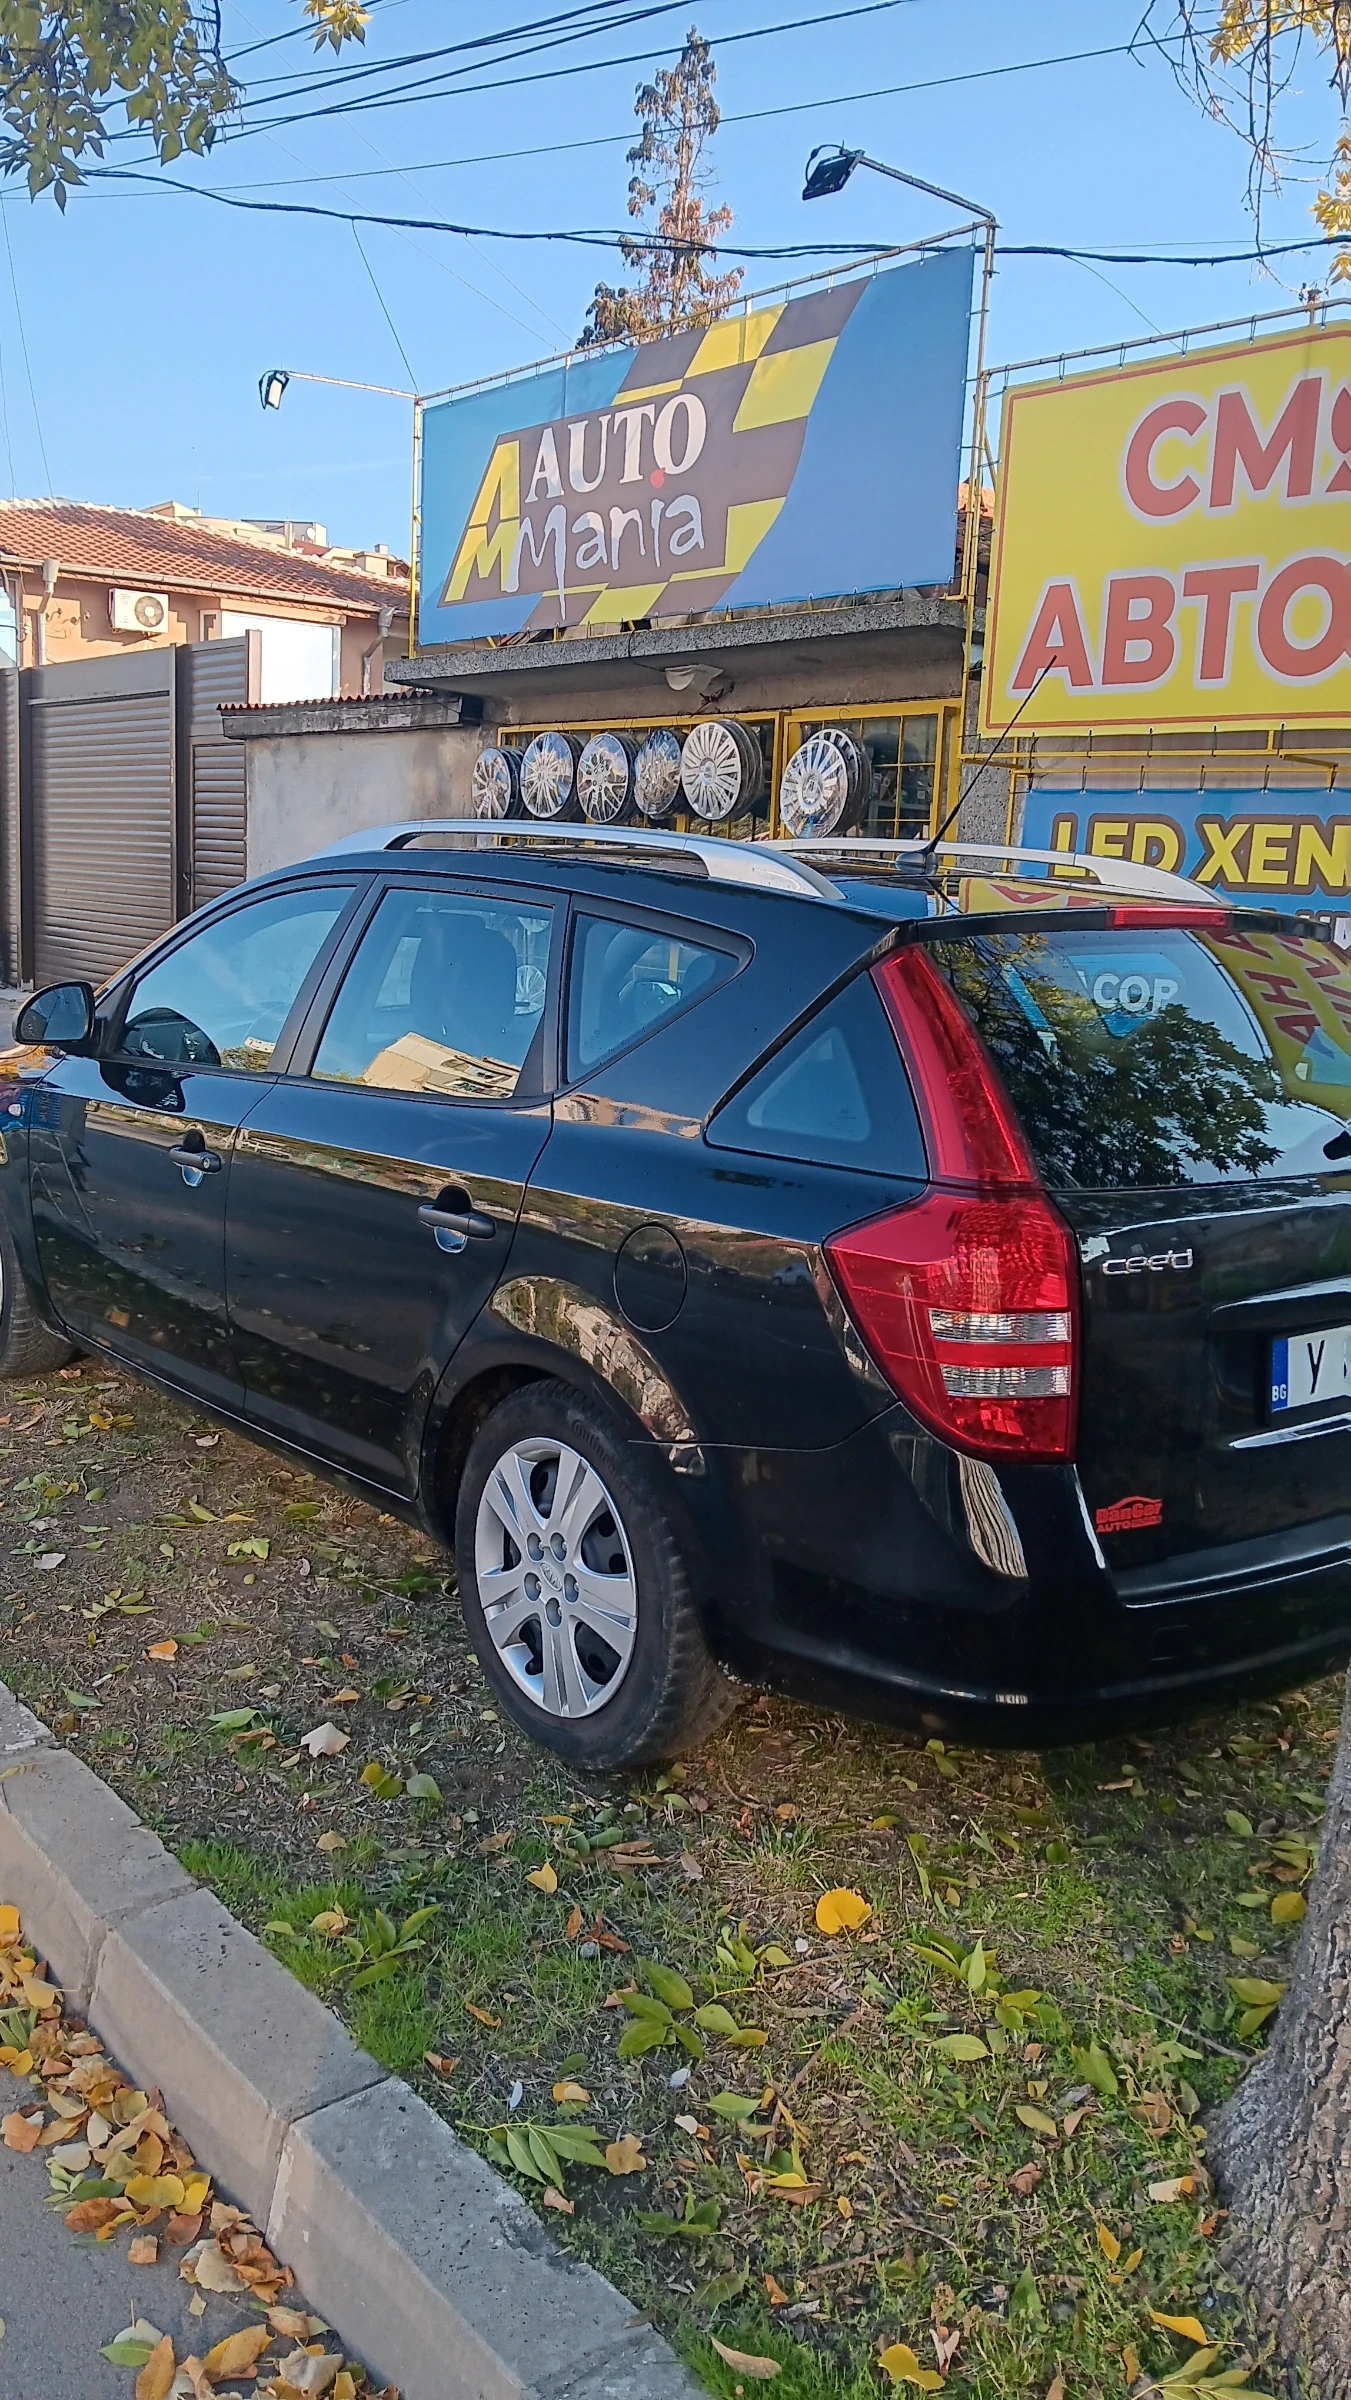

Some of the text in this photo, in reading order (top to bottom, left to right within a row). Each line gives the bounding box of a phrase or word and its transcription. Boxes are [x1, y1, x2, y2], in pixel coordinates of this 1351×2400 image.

[525, 393, 706, 503] AUTO
[505, 494, 705, 621] Mania
[1053, 821, 1179, 878] LED
[1272, 1384, 1287, 1401] BG
[1097, 1520, 1131, 1533] AUTO
